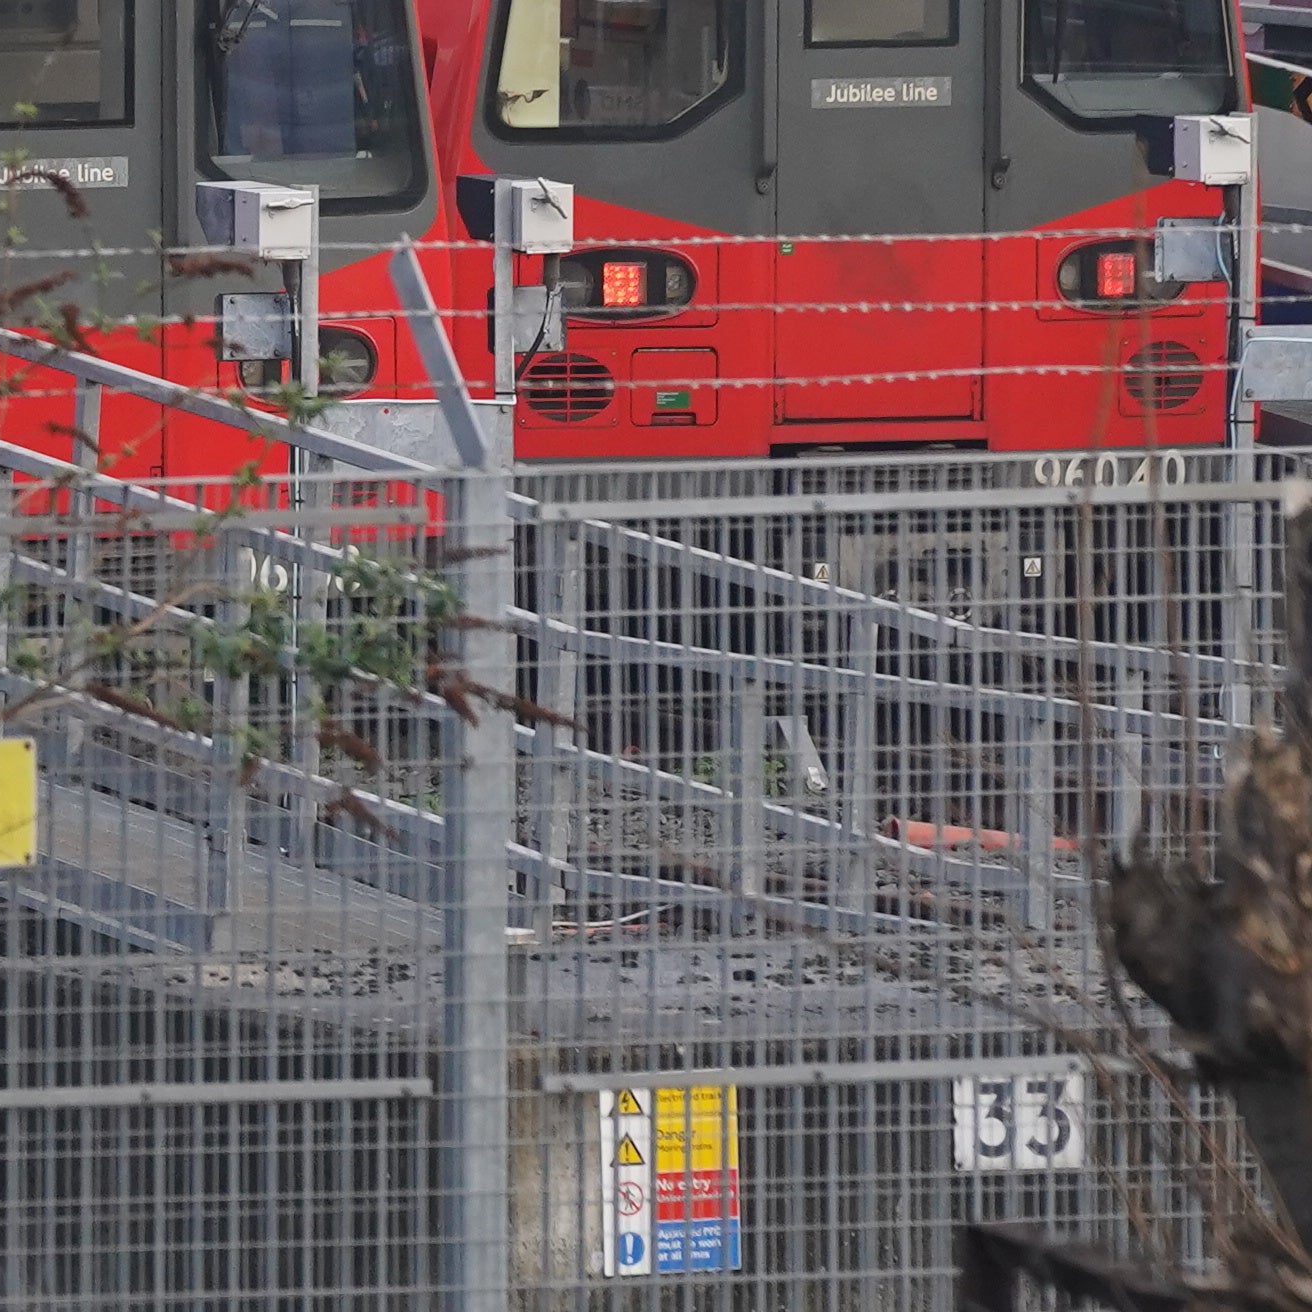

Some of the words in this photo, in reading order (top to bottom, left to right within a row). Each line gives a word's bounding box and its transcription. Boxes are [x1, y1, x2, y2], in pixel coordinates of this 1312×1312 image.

[826, 83, 895, 103] Jubilee
[903, 82, 938, 101] line
[78, 163, 114, 183] line
[977, 1081, 1071, 1158] 33
[655, 1129, 696, 1142] Dangr
[656, 1178, 674, 1191] No
[678, 1178, 711, 1191] etry
